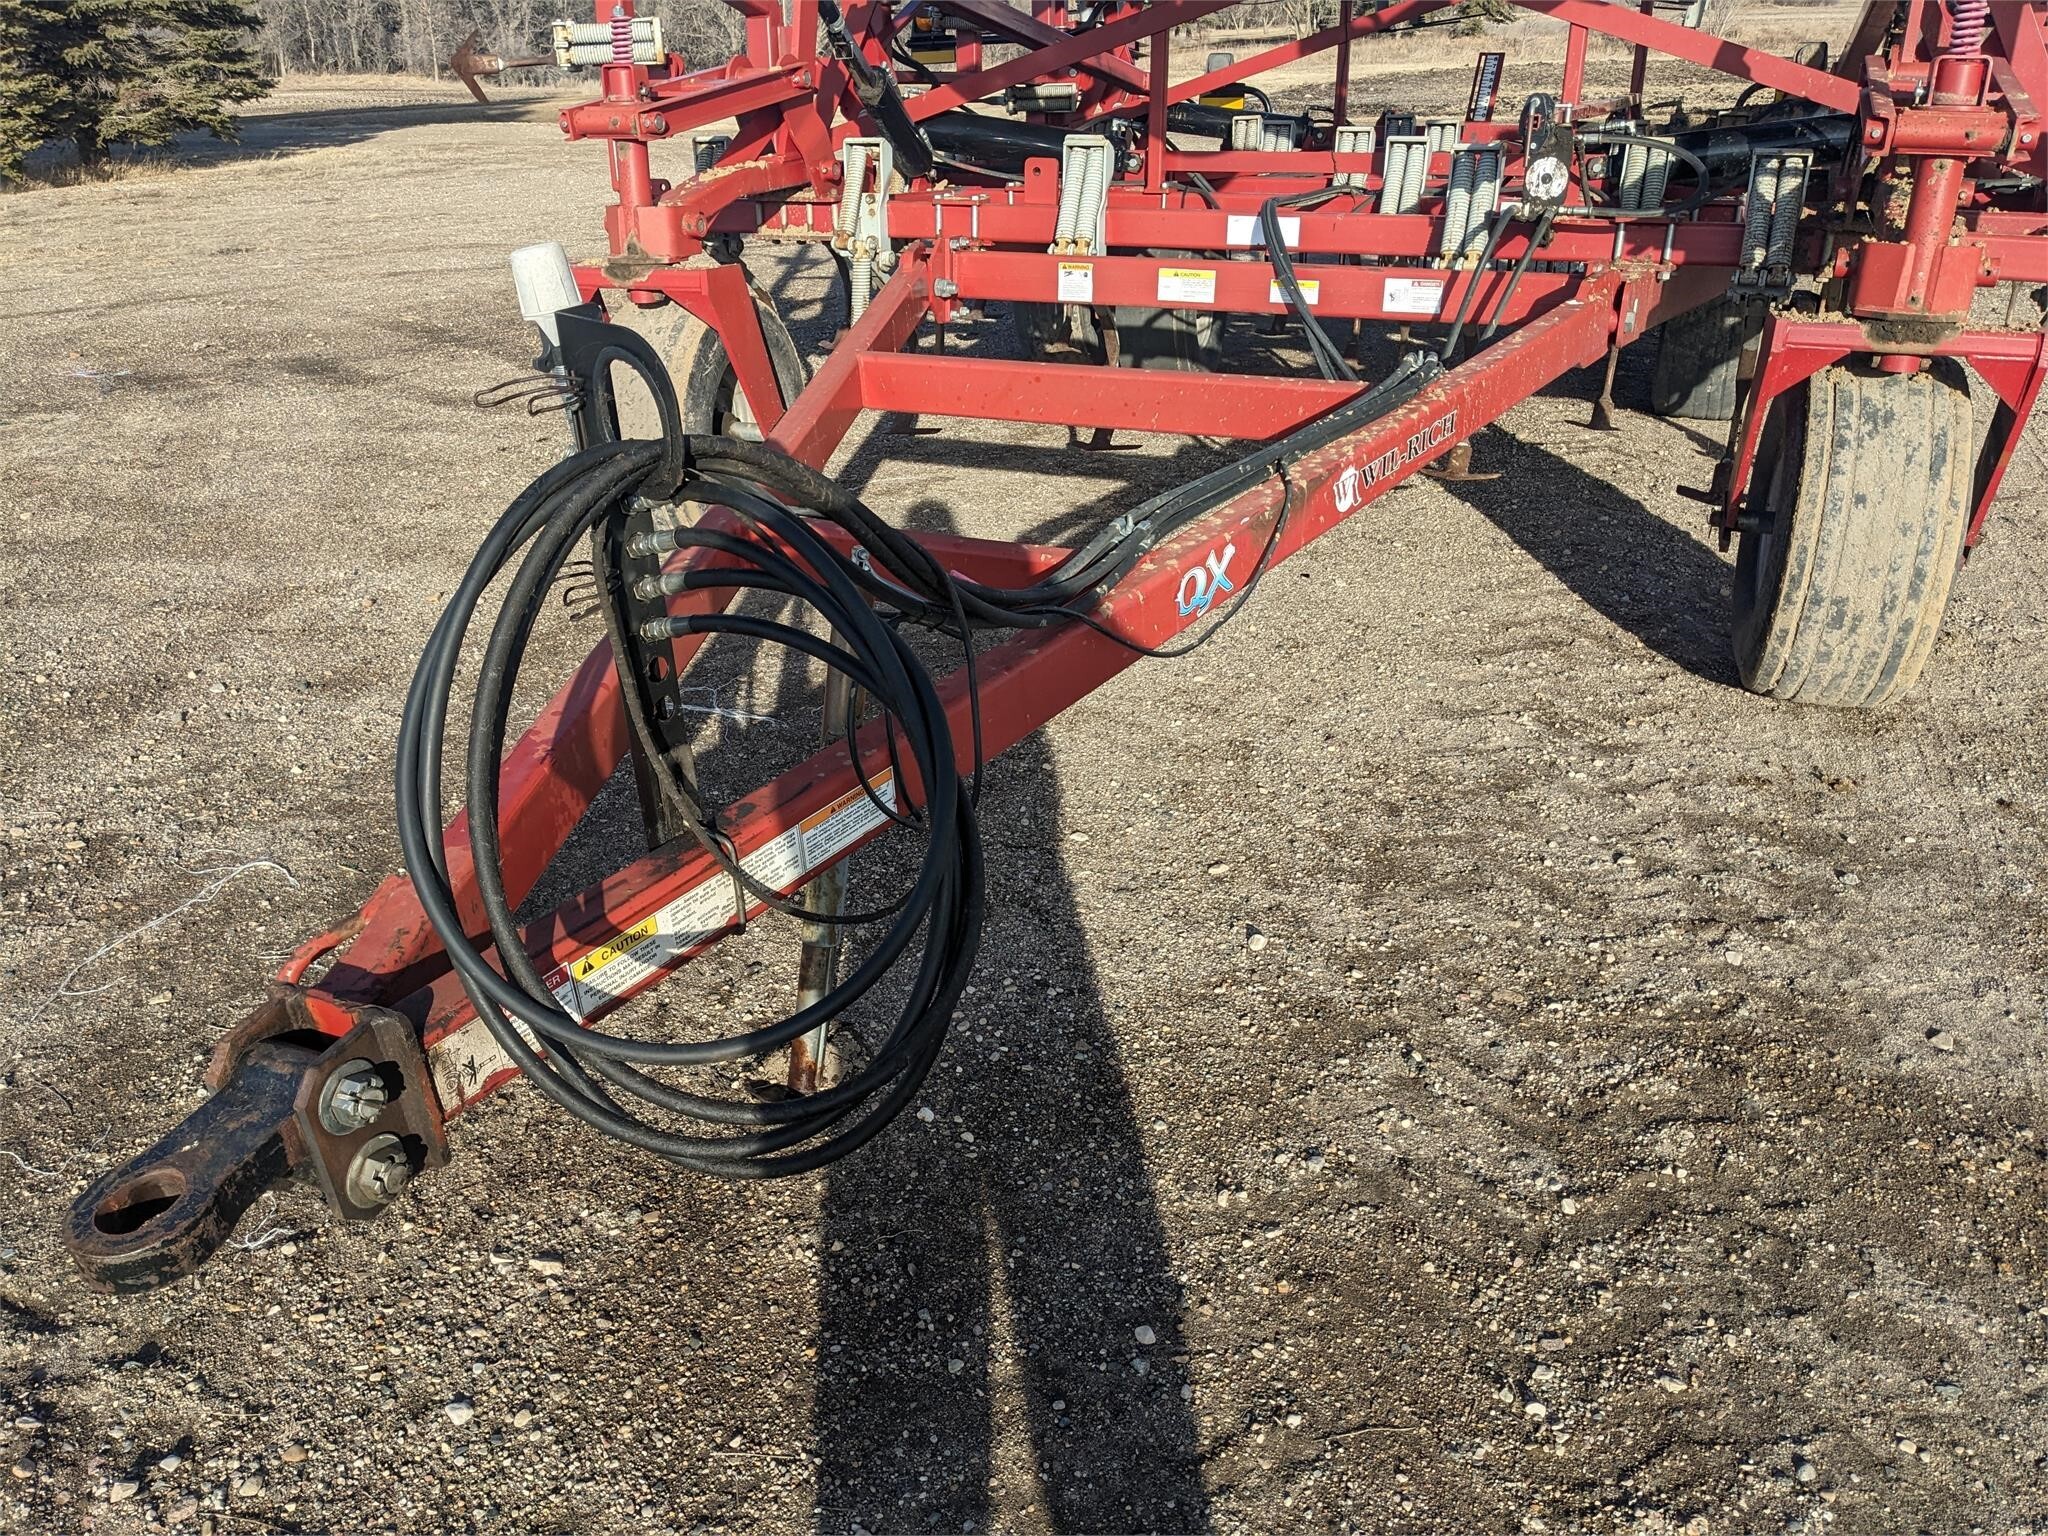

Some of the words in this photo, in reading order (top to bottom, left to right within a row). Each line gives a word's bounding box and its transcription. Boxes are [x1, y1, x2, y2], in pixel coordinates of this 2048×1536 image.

[1360, 410, 1458, 488] WIL-RICH
[1174, 542, 1236, 617] QX
[837, 789, 863, 809] WARNING
[586, 970, 607, 986] FAILURE
[618, 951, 638, 966] FOLLOW
[640, 940, 656, 952] THESE
[601, 927, 648, 961] CAUTION
[584, 970, 621, 995] INSTRUCTIONS
[622, 961, 633, 970] MAY
[635, 948, 653, 962] RESULT
[590, 979, 616, 998] PERSONAL
[619, 966, 636, 979] INJURY
[638, 953, 656, 967] AND/OR
[599, 979, 627, 1000] EQUIPMENT
